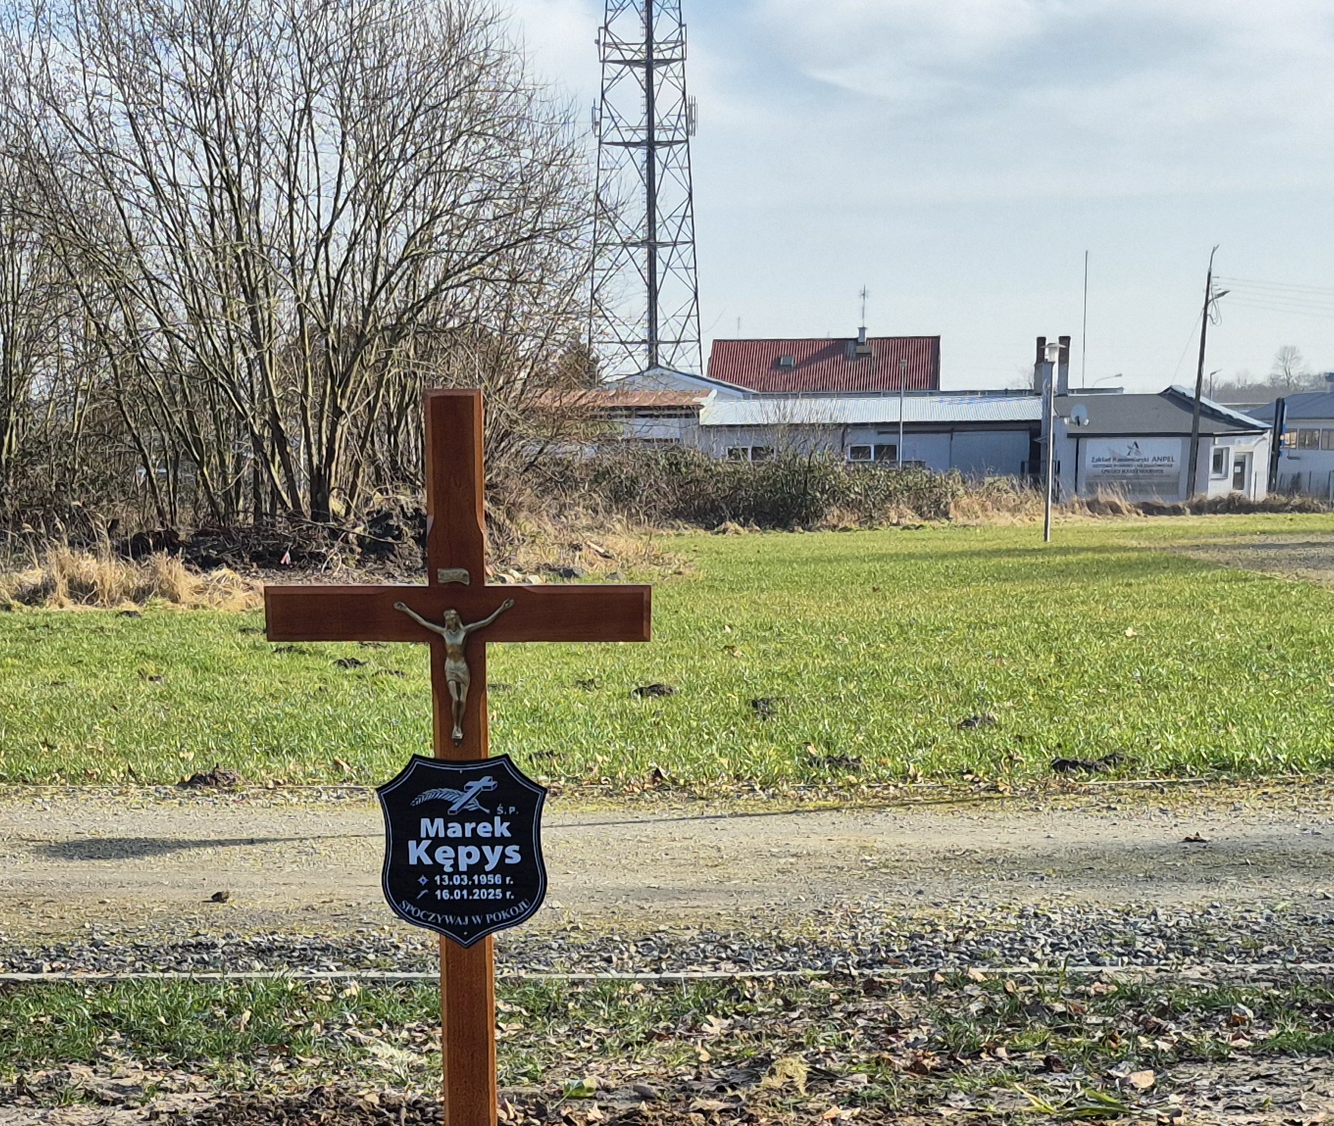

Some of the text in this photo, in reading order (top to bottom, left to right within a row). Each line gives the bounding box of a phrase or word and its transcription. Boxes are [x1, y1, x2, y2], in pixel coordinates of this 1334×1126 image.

[420, 816, 512, 839] Marek
[407, 840, 522, 873] Kępys
[434, 873, 502, 886] 13.03.1956
[434, 888, 515, 900] 16.01.2025 r.
[399, 898, 531, 926] SPOCZYWAJ W POKOJU
